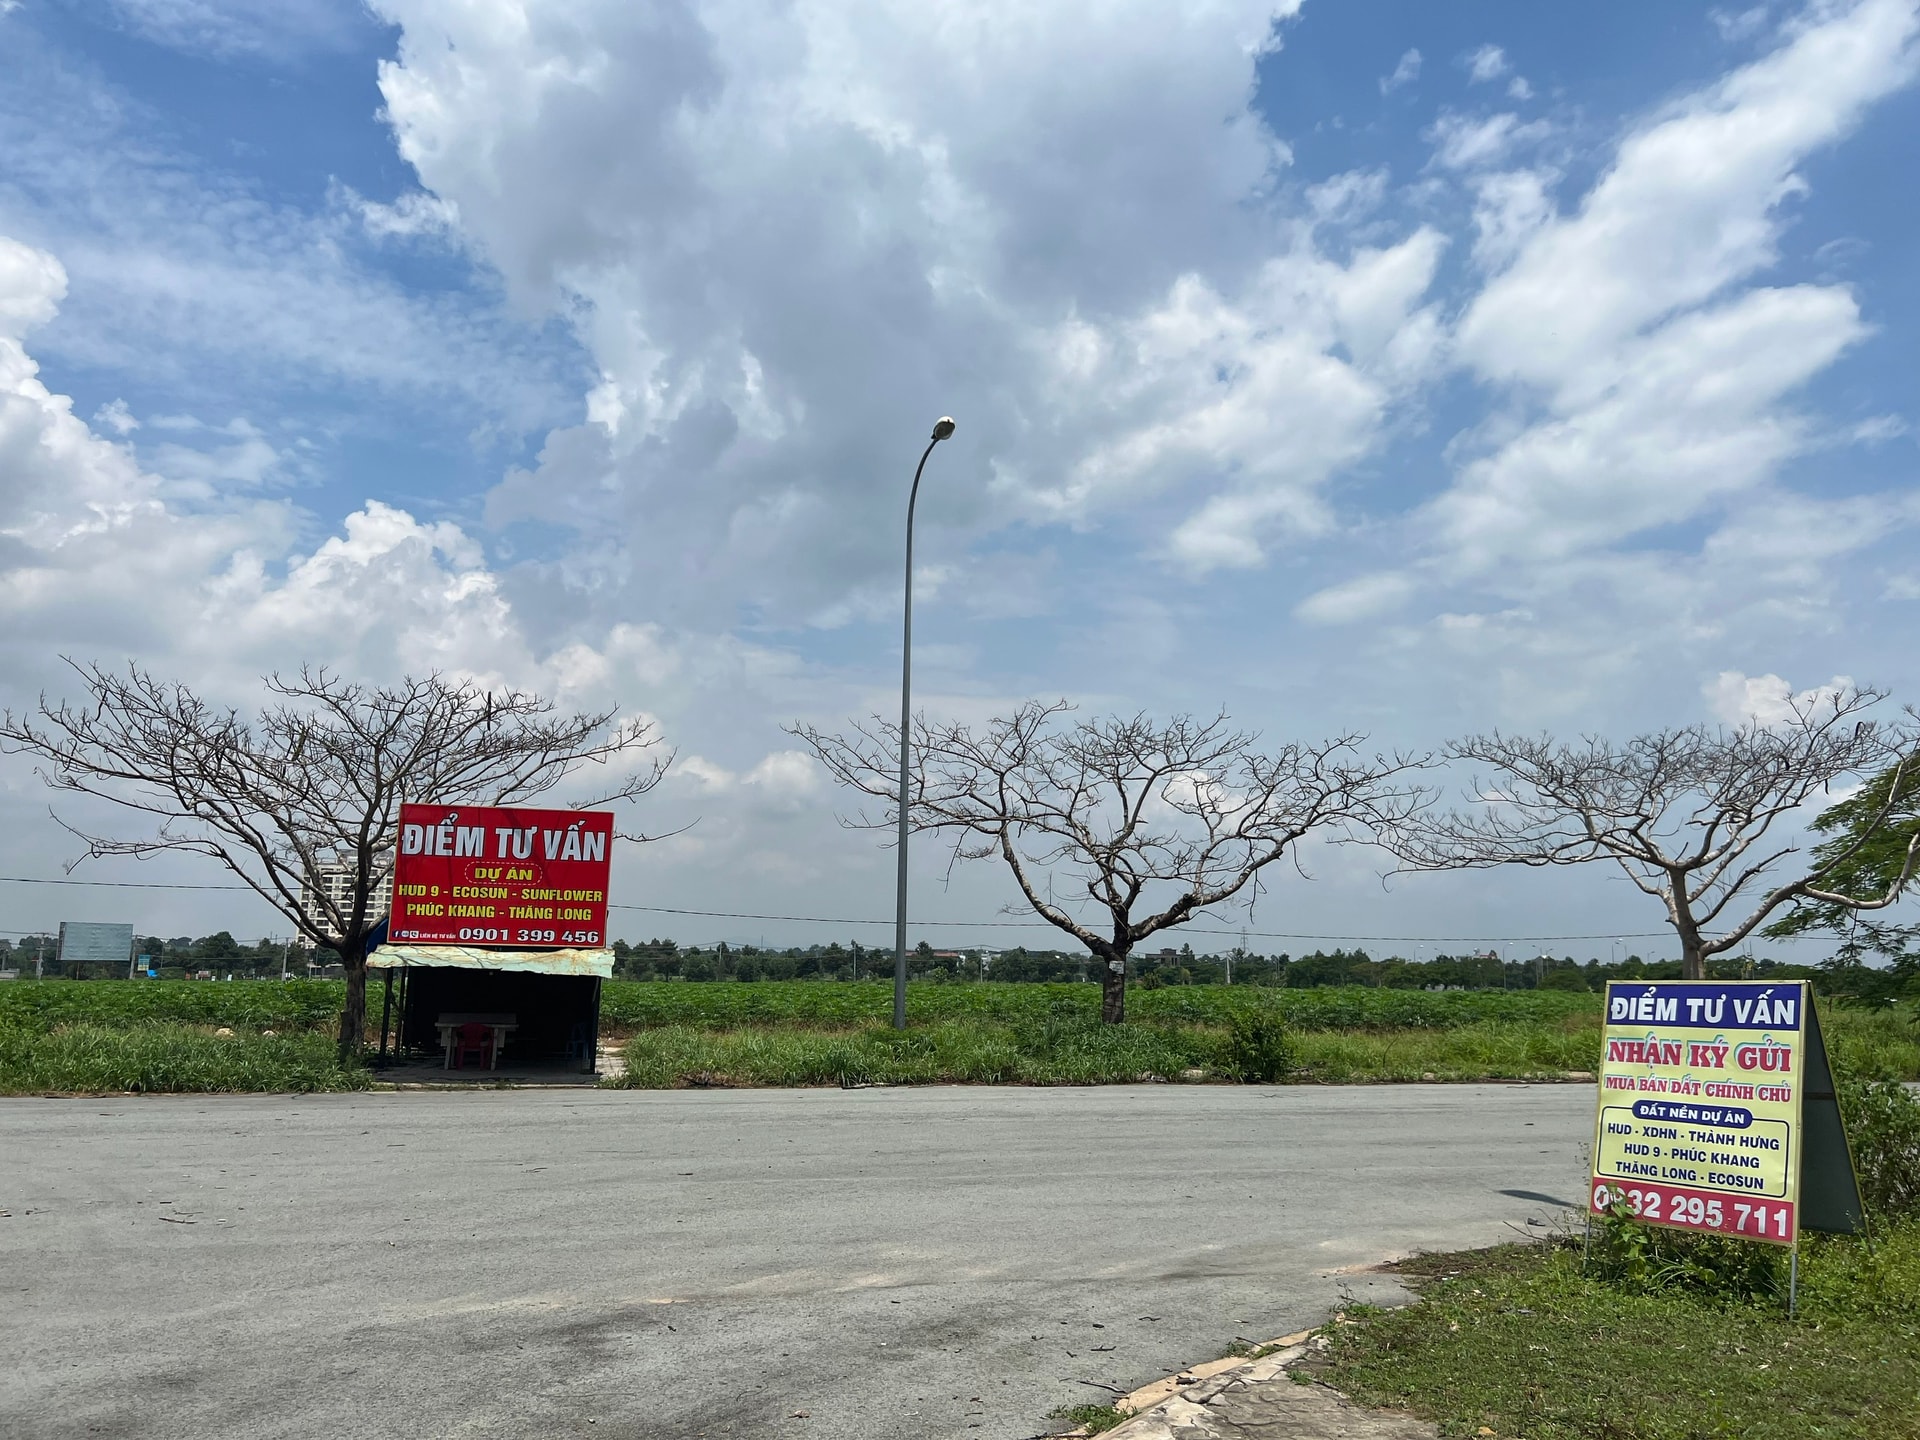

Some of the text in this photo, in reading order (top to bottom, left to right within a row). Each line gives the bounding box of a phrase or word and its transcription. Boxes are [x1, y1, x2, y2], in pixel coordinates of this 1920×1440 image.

[401, 812, 605, 861] ĐIỂM TƯ VẤN
[474, 867, 533, 882] DỰ ÁN
[399, 885, 425, 896] HUD
[430, 885, 439, 896] 9
[453, 887, 508, 899] ECOSUN
[521, 889, 602, 902] SUNFLOWER
[407, 902, 444, 916] PHÚC
[448, 905, 495, 917] KHANG
[509, 904, 552, 919] THĂNG
[557, 909, 592, 920] LONG
[459, 928, 599, 943] 0901 399 456
[1611, 987, 1795, 1025] ĐIỂM TƯ VẤN
[1607, 1033, 1791, 1072] NHẬN KÝ GỬI
[1605, 1074, 1791, 1103] MUA BÁN ĐẤT CHÍNH CHỦ
[1640, 1103, 1744, 1124] ĐẤT NỀN DỰ ÁN
[1608, 1123, 1632, 1135] HUD
[1643, 1127, 1677, 1139] XDHN
[1689, 1130, 1735, 1146] THÀNH
[1739, 1135, 1780, 1150] HƯNG
[1624, 1144, 1649, 1156] HUD
[1653, 1147, 1661, 1157] 9
[1672, 1146, 1707, 1163] PHÚC
[1711, 1153, 1760, 1168] KHANG
[1616, 1161, 1658, 1177] THĂNG
[1662, 1166, 1696, 1181] LONG
[1708, 1173, 1764, 1189] ECOSUN
[1670, 1195, 1723, 1227] 295
[1734, 1205, 1787, 1236] 711
